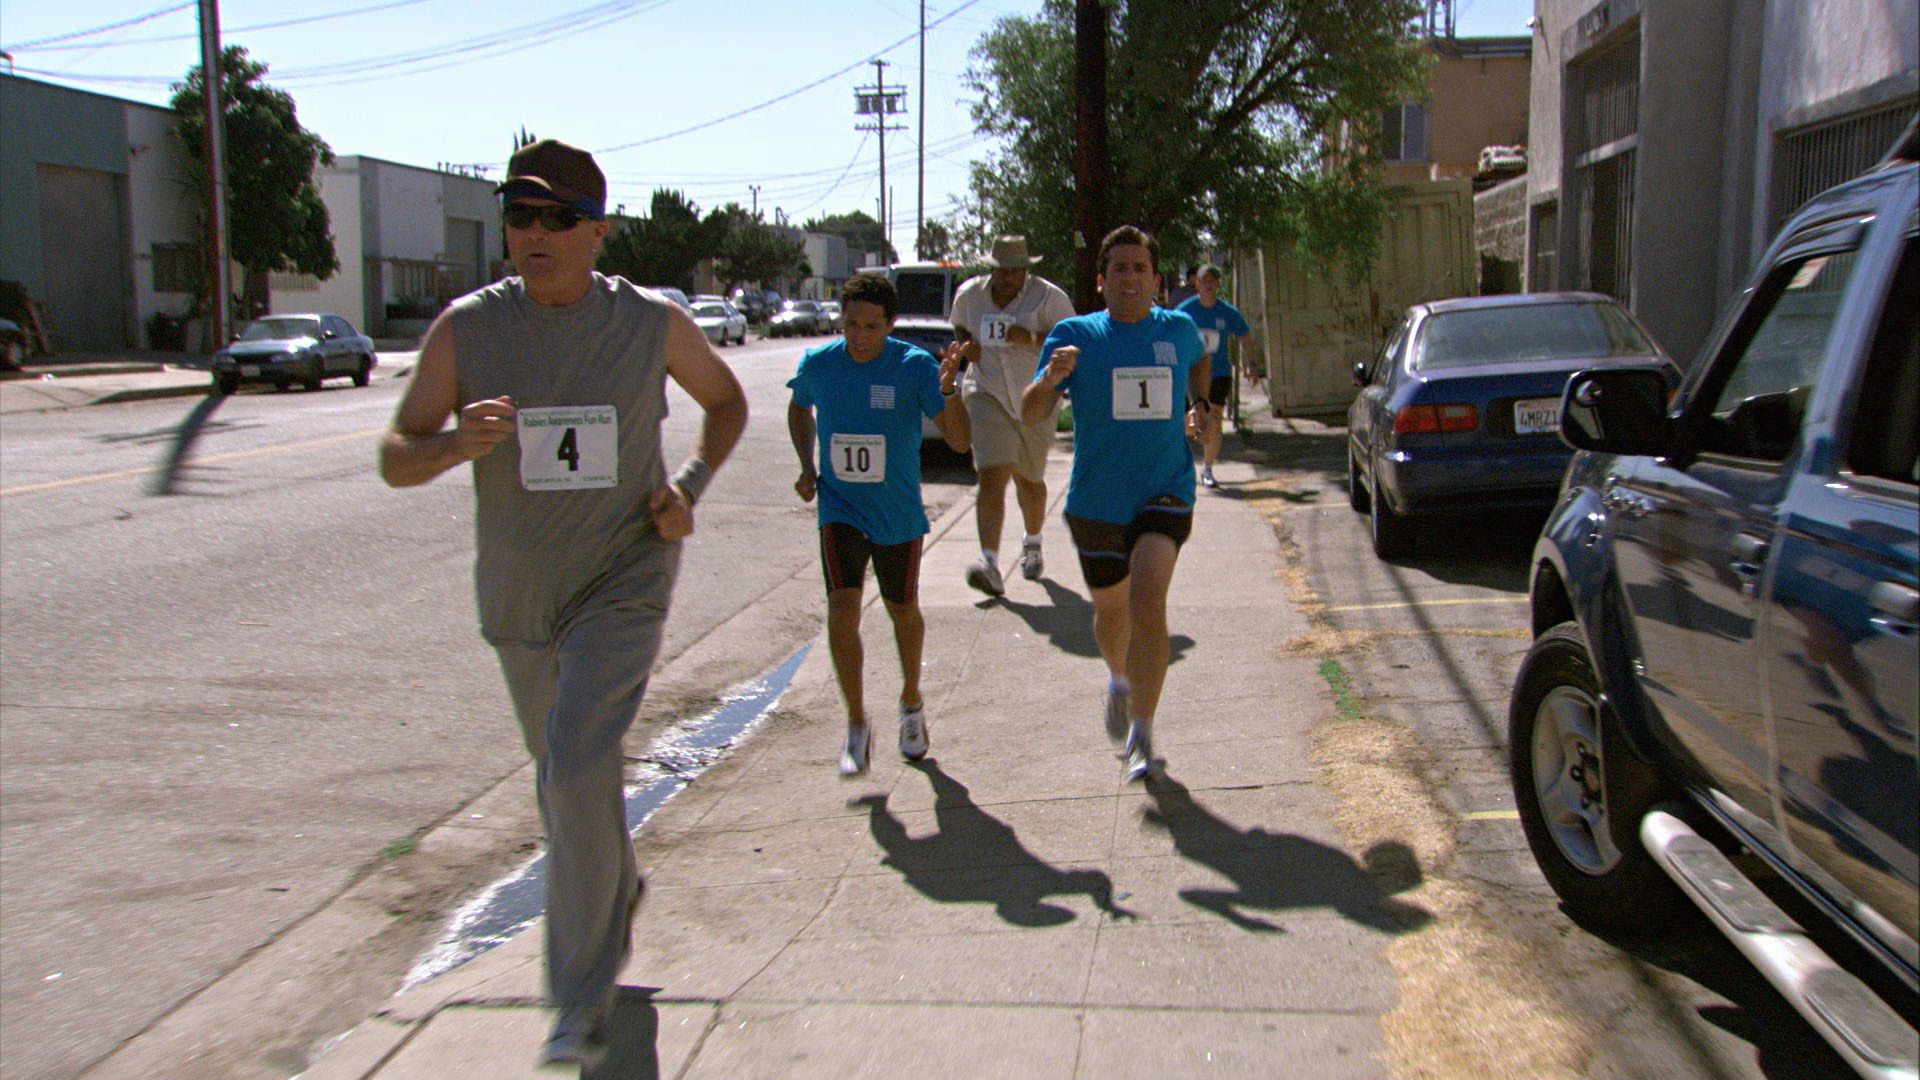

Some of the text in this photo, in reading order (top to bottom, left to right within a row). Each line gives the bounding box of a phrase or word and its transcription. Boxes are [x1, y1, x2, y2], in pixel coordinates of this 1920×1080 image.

[989, 320, 1005, 339] 13
[1139, 380, 1149, 408] 1
[558, 428, 579, 471] 4
[844, 446, 870, 472] 10
